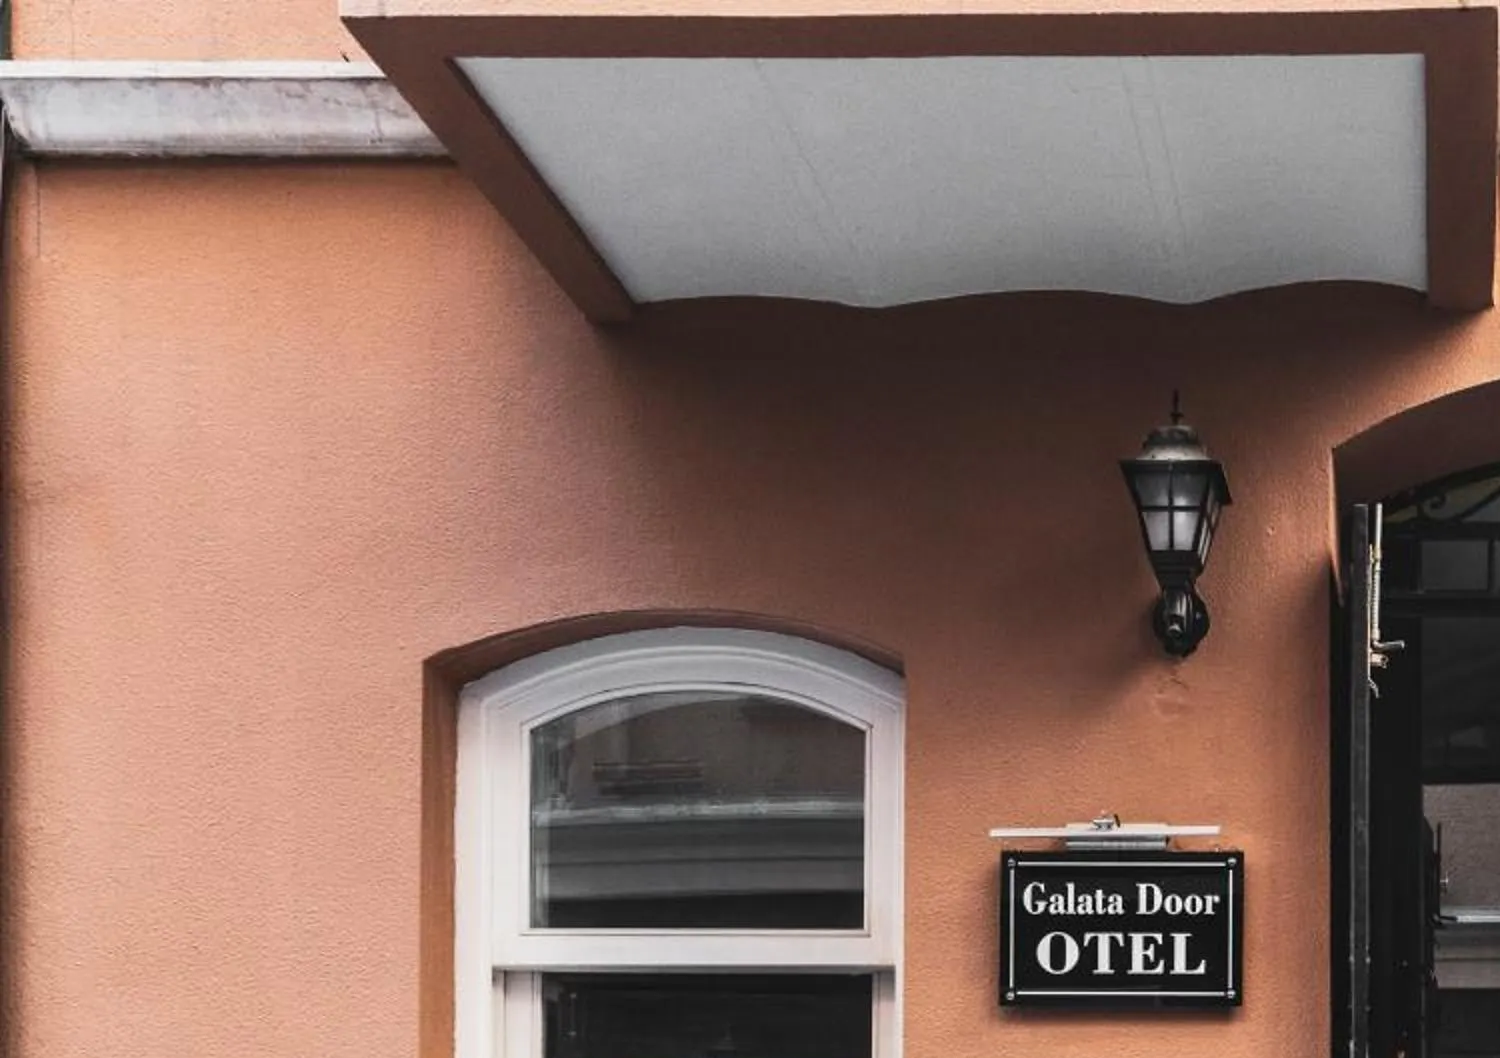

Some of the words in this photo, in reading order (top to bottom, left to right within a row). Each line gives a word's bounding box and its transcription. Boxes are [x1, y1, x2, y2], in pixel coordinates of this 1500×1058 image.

[1023, 882, 1124, 915] Galata
[1136, 882, 1220, 915] Door
[1036, 931, 1206, 975] OTEL
